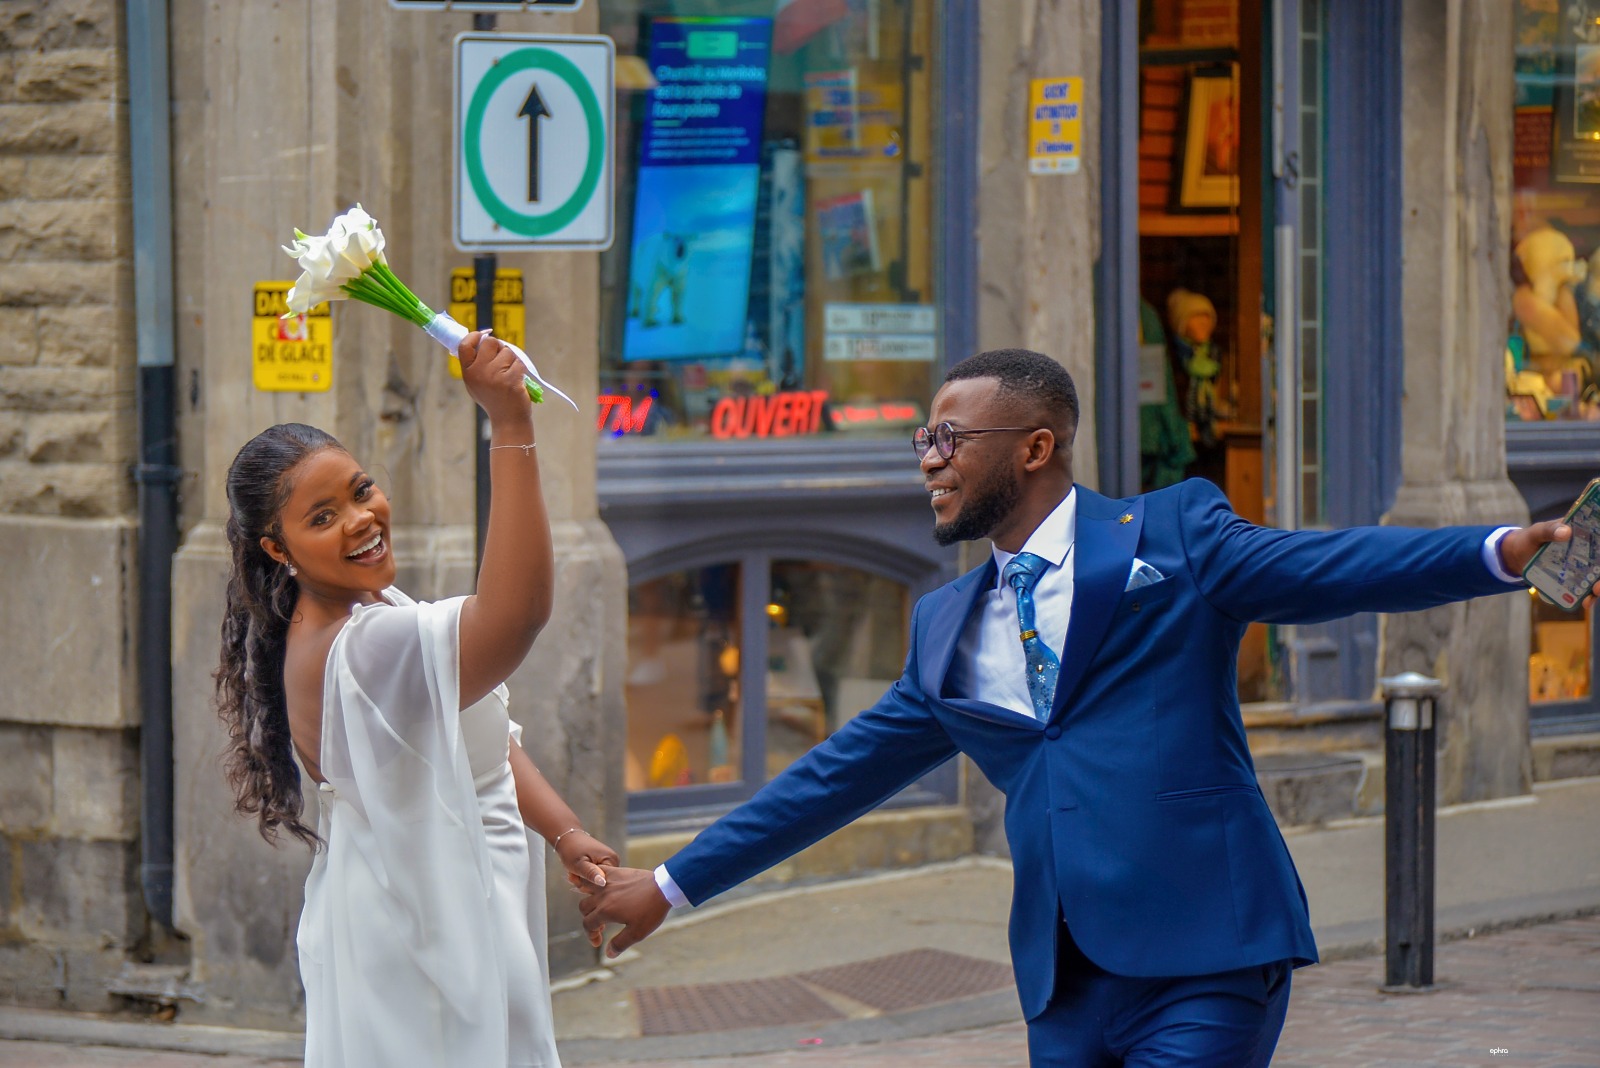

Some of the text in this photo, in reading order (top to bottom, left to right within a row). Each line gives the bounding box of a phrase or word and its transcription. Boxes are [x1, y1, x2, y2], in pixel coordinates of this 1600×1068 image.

[258, 343, 325, 364] DE GLACE
[712, 391, 828, 440] OUVERT
